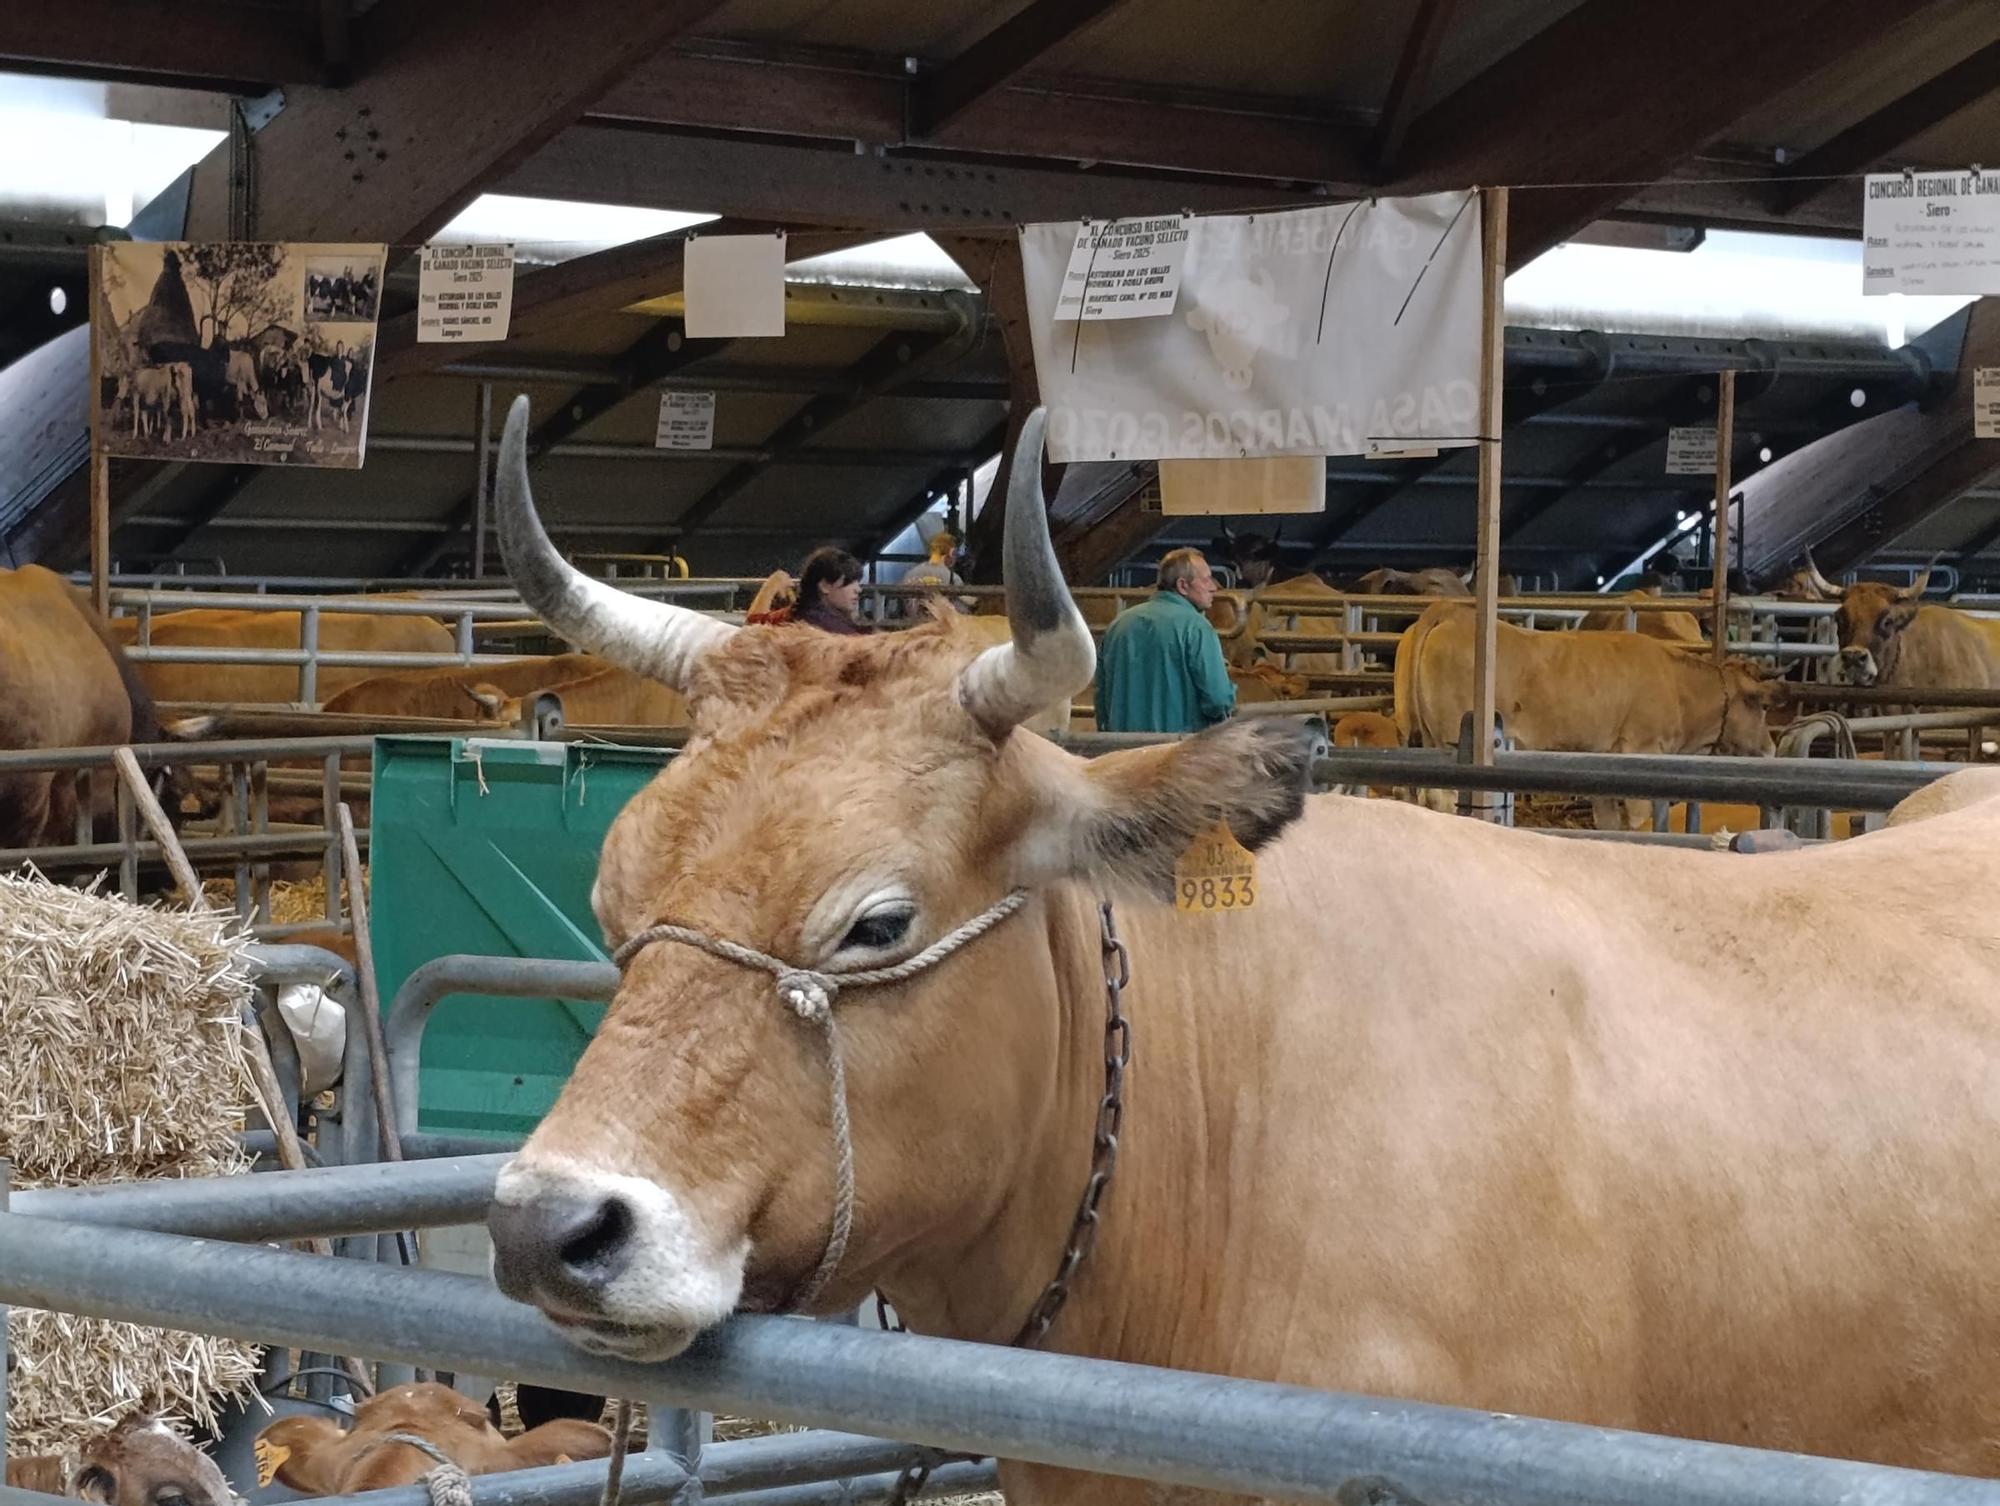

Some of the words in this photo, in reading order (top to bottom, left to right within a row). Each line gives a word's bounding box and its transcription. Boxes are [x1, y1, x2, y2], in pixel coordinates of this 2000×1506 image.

[1869, 180, 1914, 199] CONCURSO
[1917, 178, 1957, 197] REGIONAL
[1961, 177, 1972, 196] DE
[1926, 202, 1951, 217] Siero
[1090, 225, 1099, 236] XL
[1103, 222, 1142, 236] CONCURSO
[1145, 218, 1181, 232] REGIONAL
[1077, 238, 1088, 249] DE
[1091, 236, 1122, 249] GANADO
[1125, 233, 1154, 246] VACUNO
[1156, 230, 1189, 244] SELECTO
[1113, 249, 1132, 260] Siero
[1132, 247, 1151, 259] 2025
[486, 257, 513, 270] SELECTO
[1136, 267, 1148, 276] LOS
[1181, 875, 1255, 909] 9833
